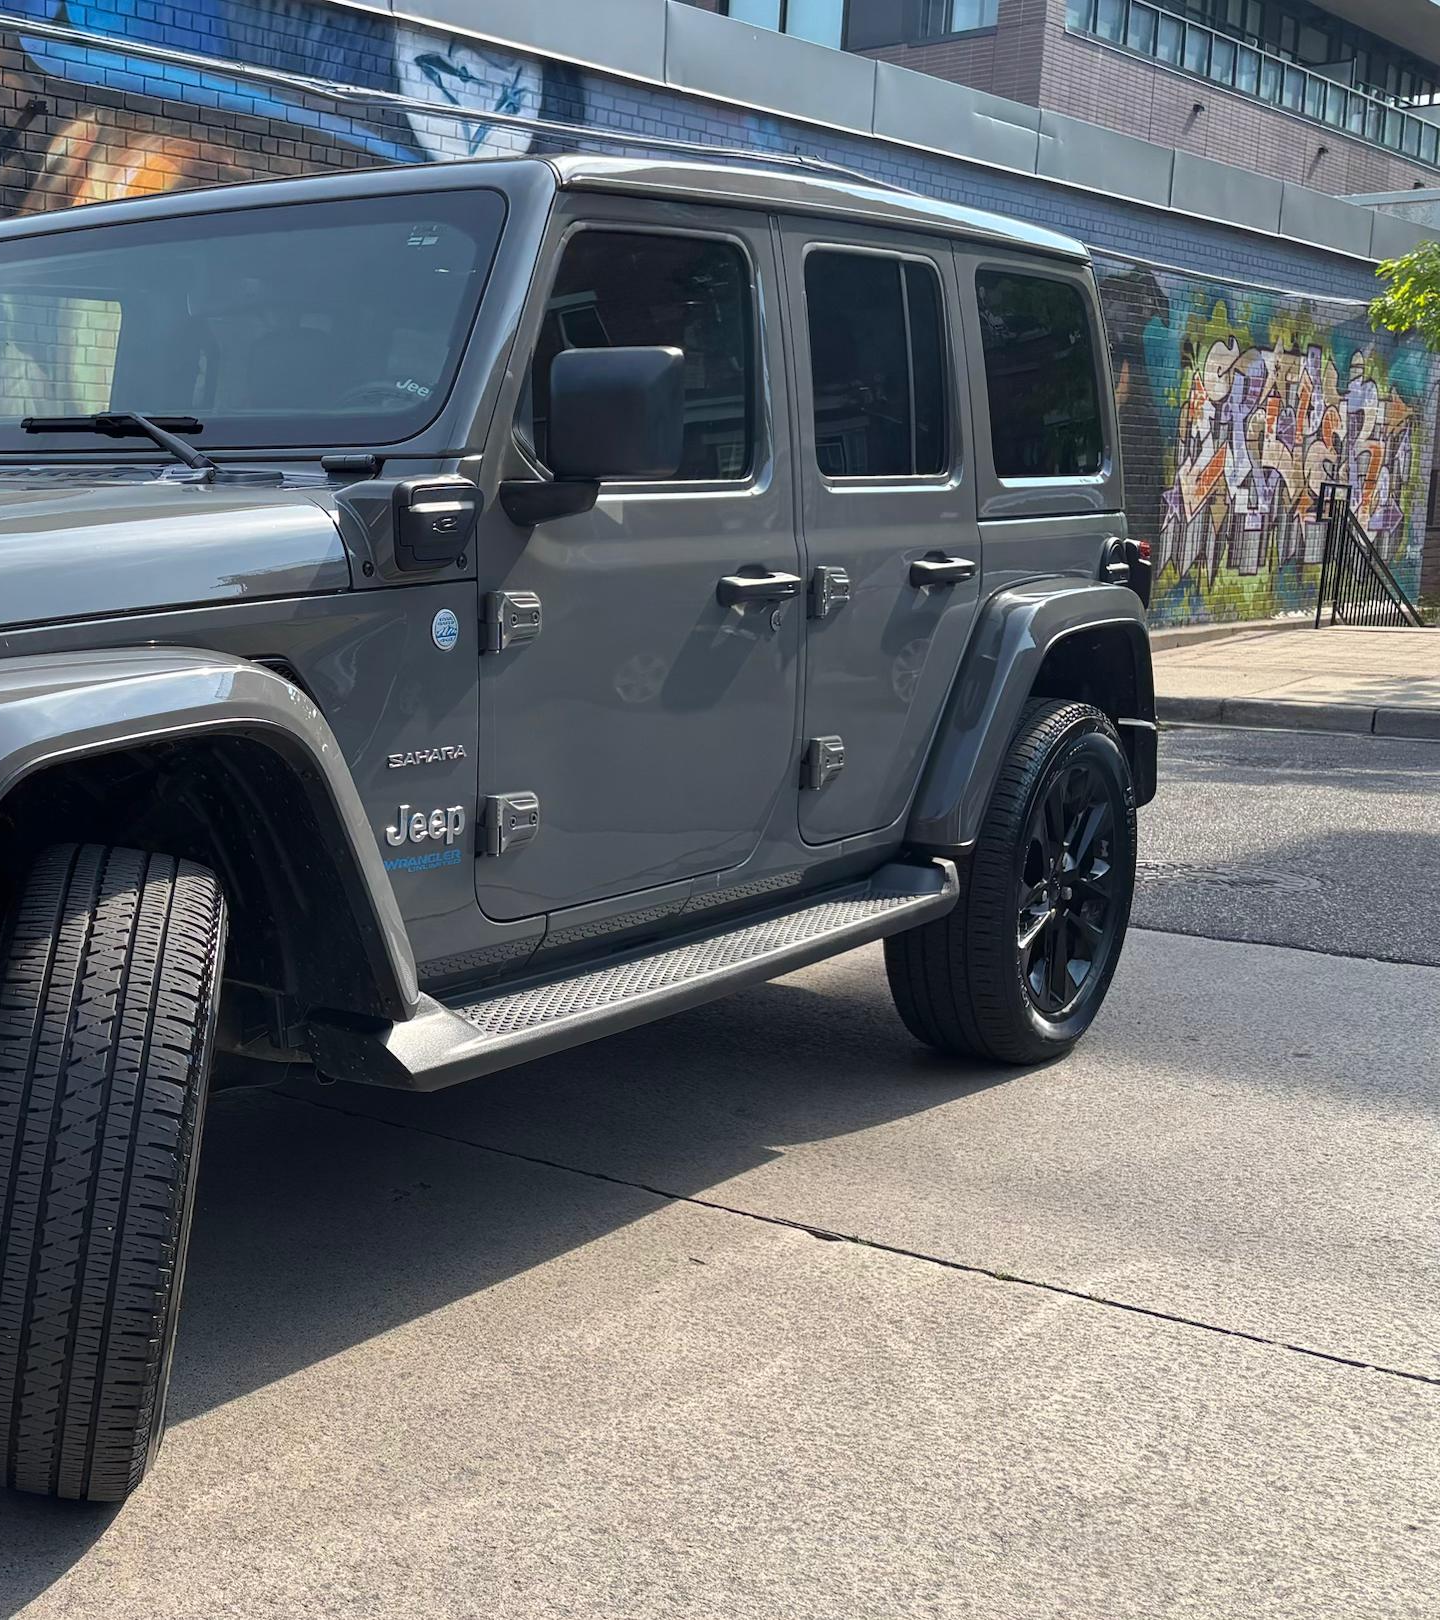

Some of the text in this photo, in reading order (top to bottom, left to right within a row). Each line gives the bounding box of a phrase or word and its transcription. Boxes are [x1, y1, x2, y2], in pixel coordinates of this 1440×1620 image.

[388, 745, 467, 768] SAHARA
[386, 804, 466, 847] Jeep
[384, 849, 461, 871] WRANGLER
